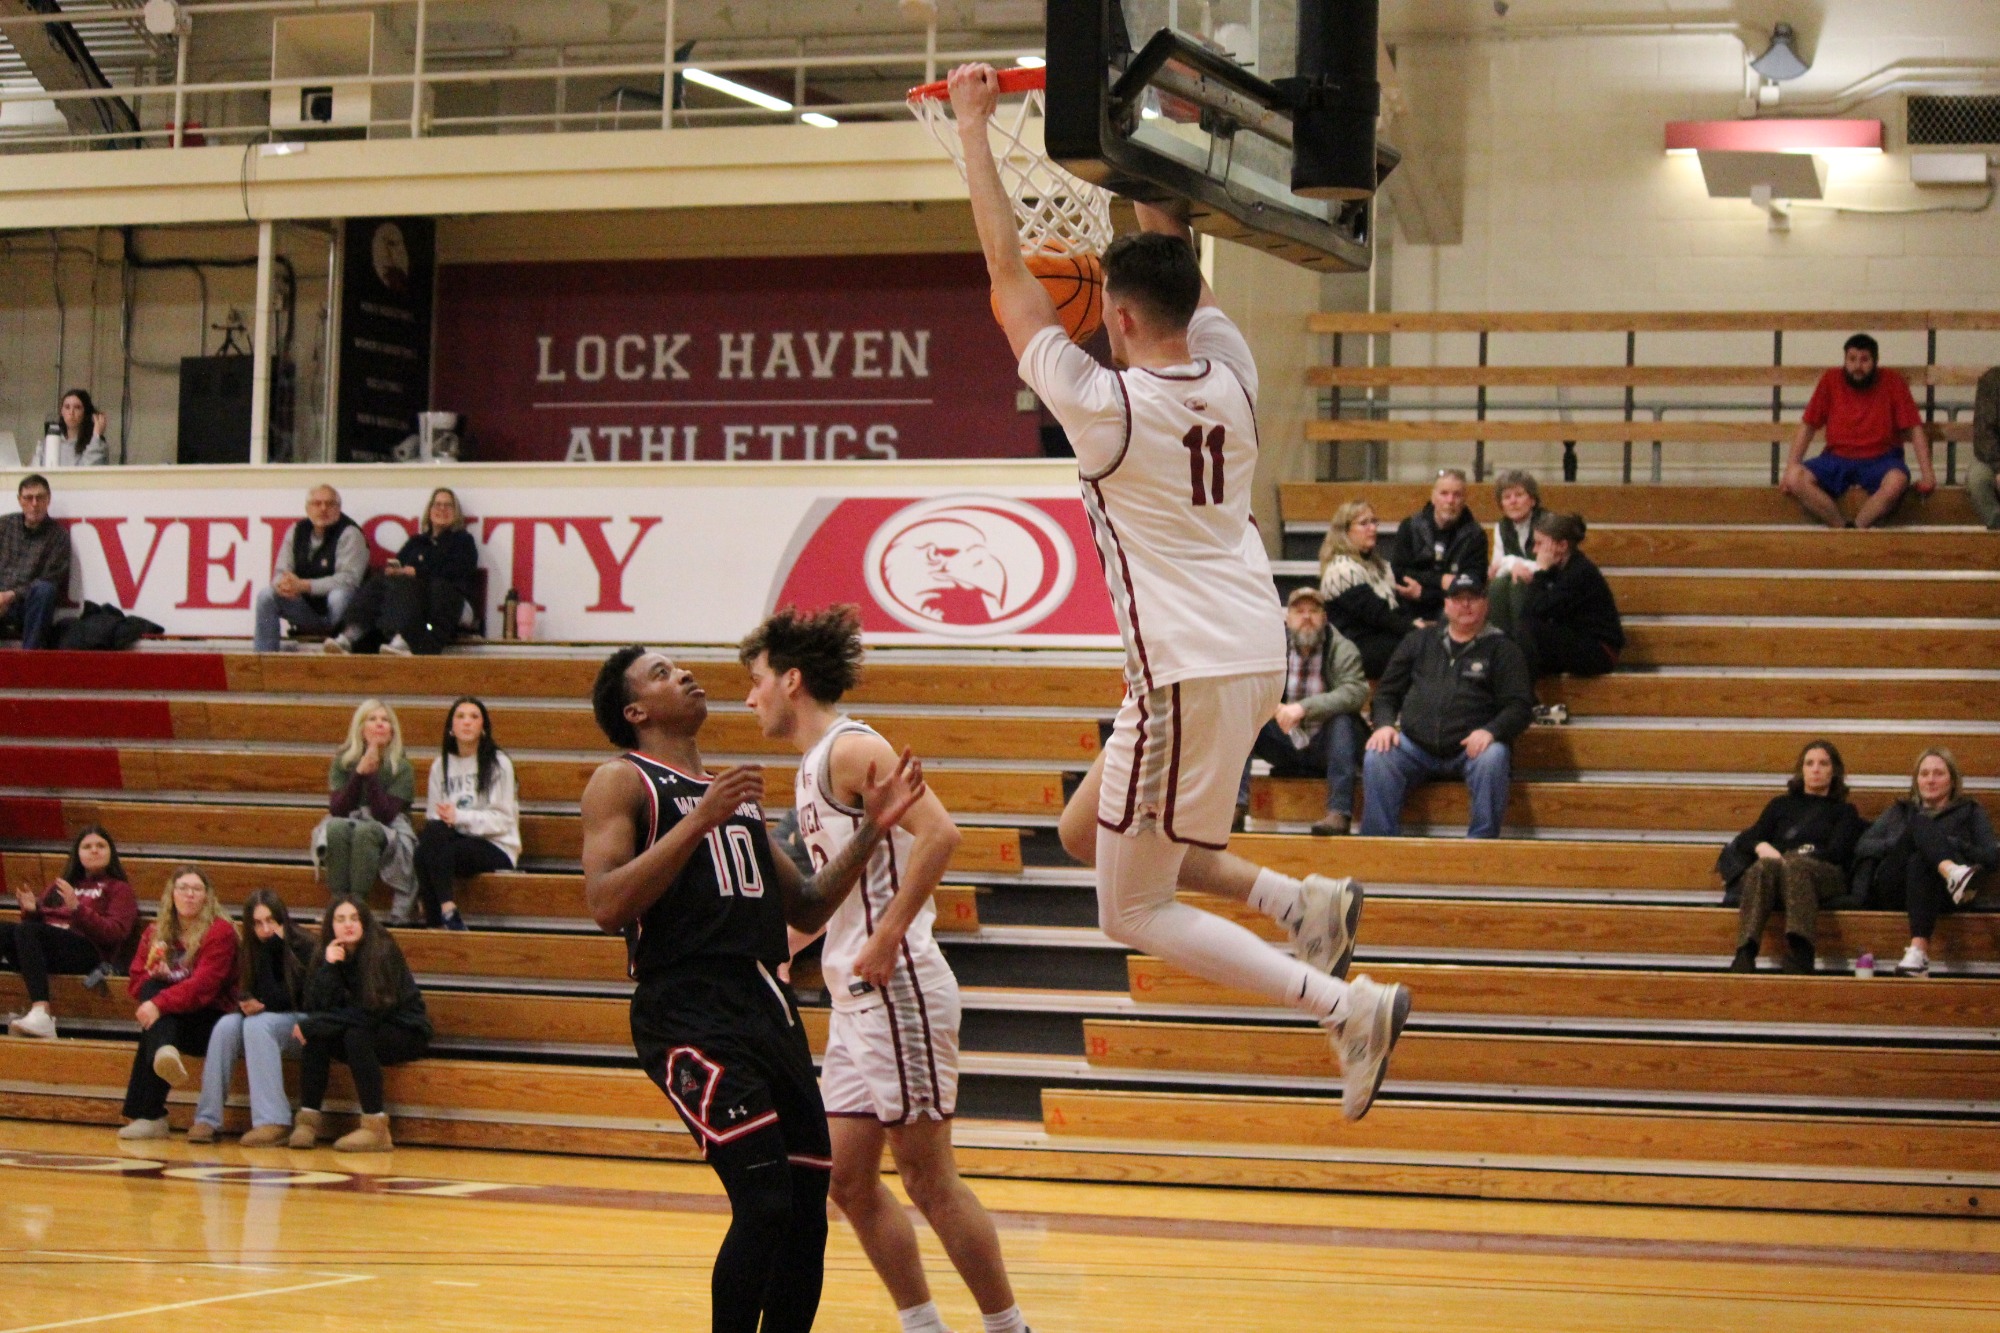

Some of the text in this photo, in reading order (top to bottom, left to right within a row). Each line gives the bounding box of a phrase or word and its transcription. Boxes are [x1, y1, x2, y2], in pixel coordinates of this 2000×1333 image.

[536, 331, 930, 381] LOCK HAVEN
[1182, 425, 1226, 506] 11
[1080, 733, 1095, 750] G
[1043, 786, 1056, 805] F
[704, 824, 764, 898] 10
[1001, 843, 1015, 862] E
[955, 903, 972, 920] D
[1136, 973, 1153, 992] C
[1091, 1037, 1107, 1057] B
[1051, 1107, 1067, 1125] A
